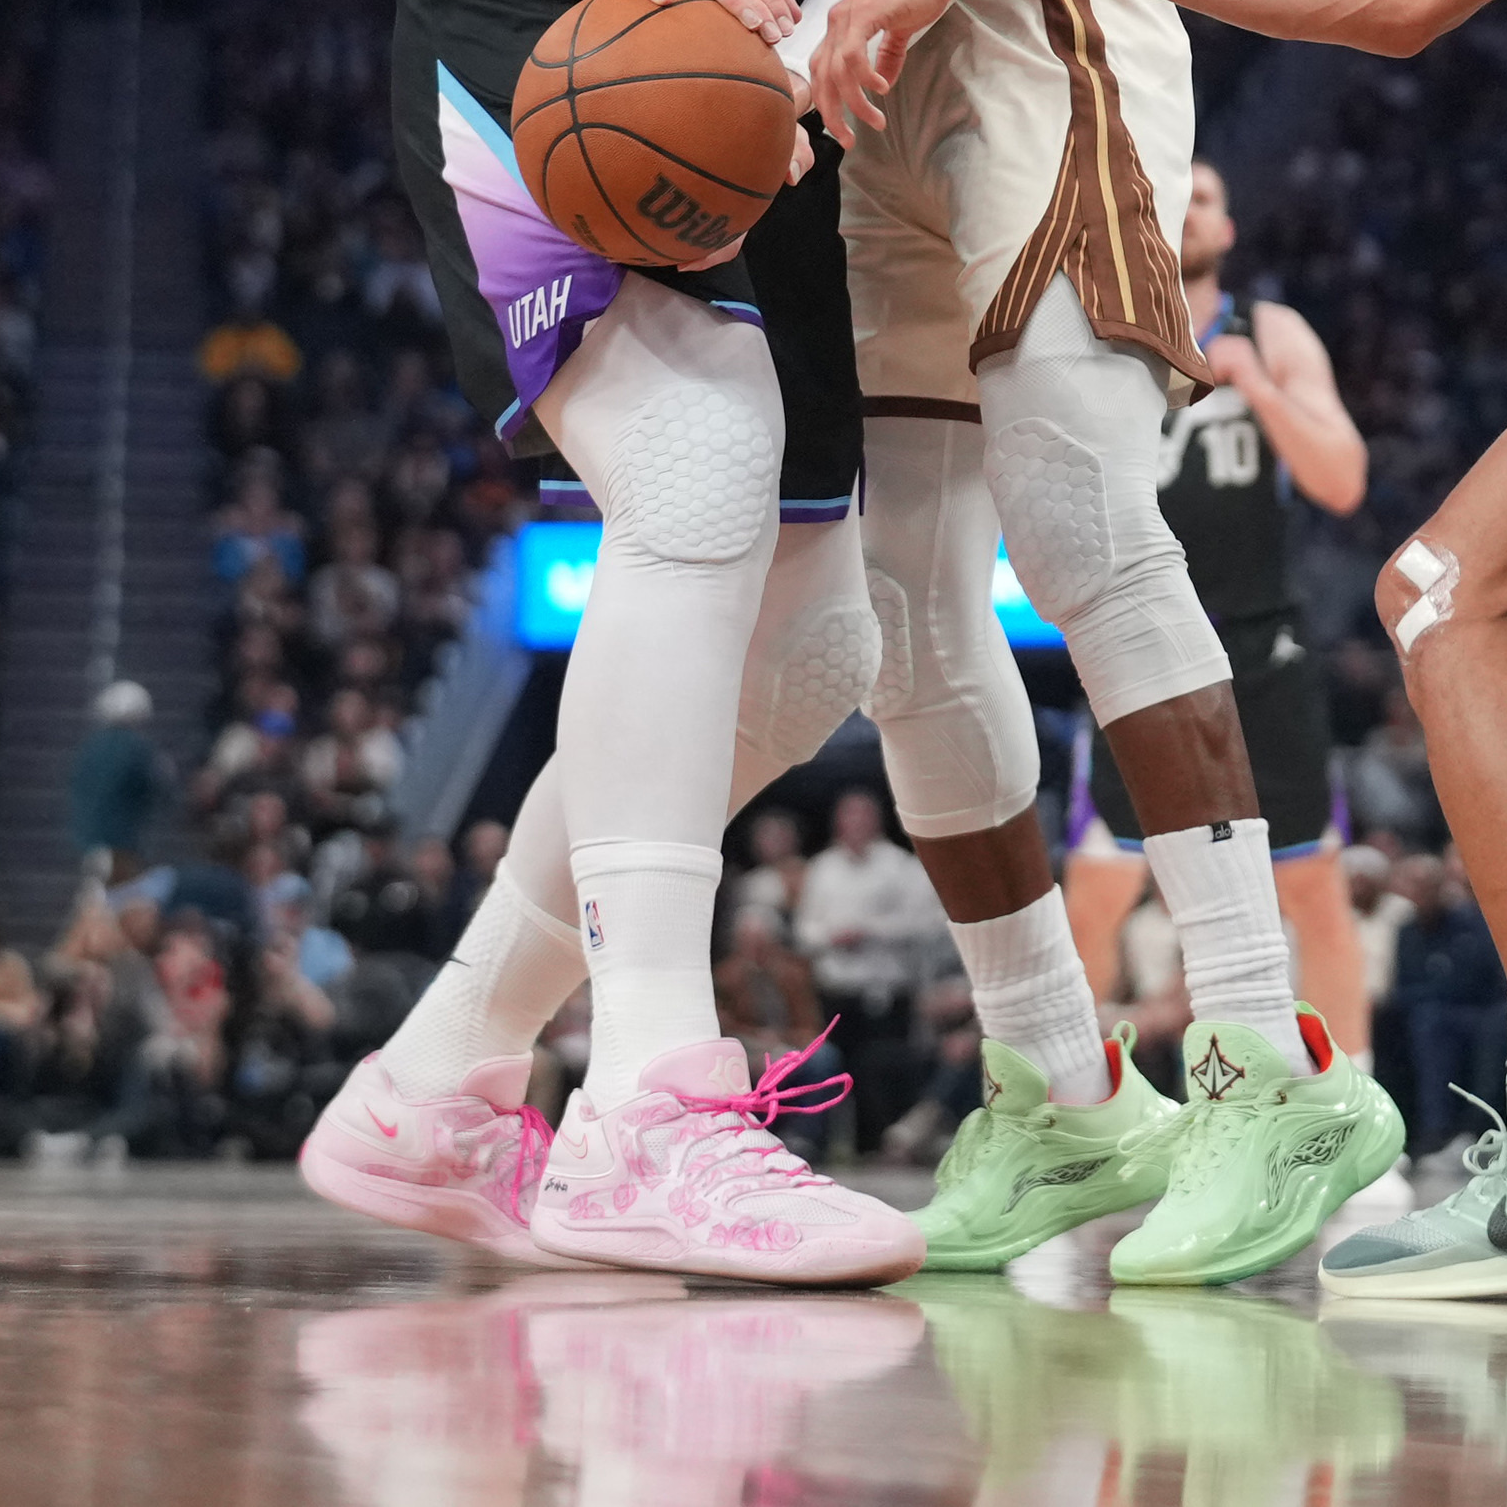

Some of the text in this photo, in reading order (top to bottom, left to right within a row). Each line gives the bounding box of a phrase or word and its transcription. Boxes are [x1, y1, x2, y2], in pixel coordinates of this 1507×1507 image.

[508, 274, 573, 349] UTAH
[1198, 419, 1259, 491] 10
[1214, 823, 1232, 839] alo
